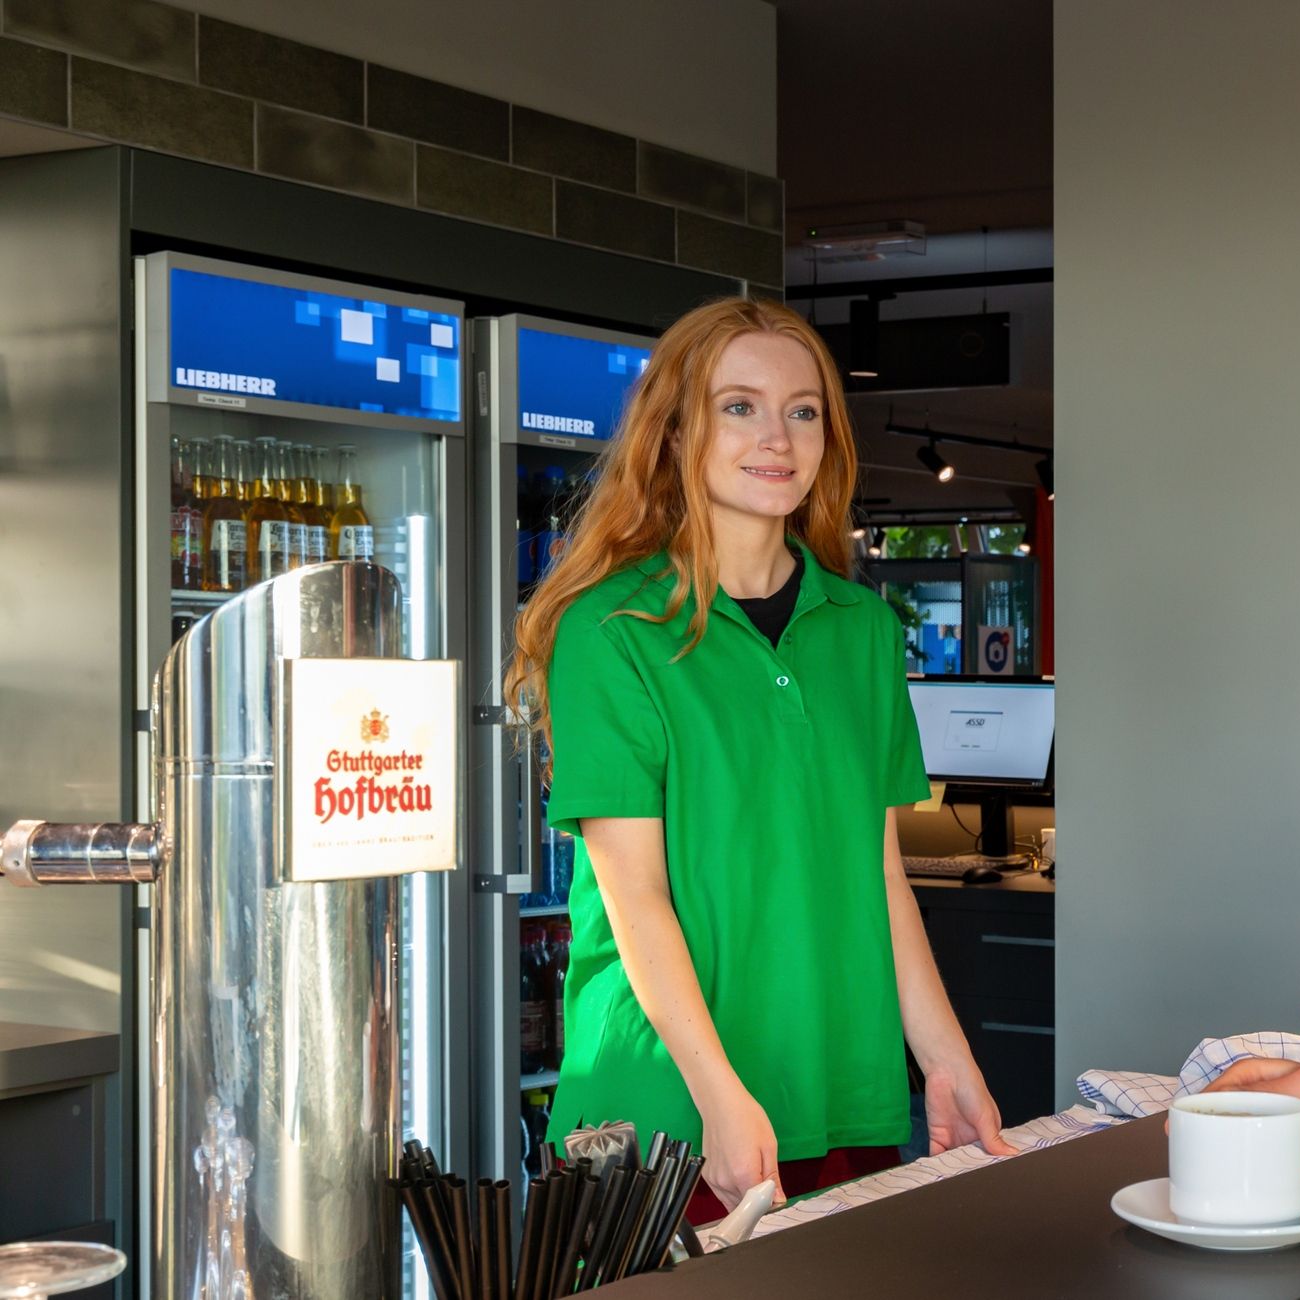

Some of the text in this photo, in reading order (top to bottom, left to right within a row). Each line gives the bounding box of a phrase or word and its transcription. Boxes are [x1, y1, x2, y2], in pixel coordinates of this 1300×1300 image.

[176, 367, 276, 396] LIEBHERR
[522, 412, 595, 435] LIEBHERR
[326, 749, 423, 776] Stuttgarter
[314, 775, 433, 824] Hofbräu
